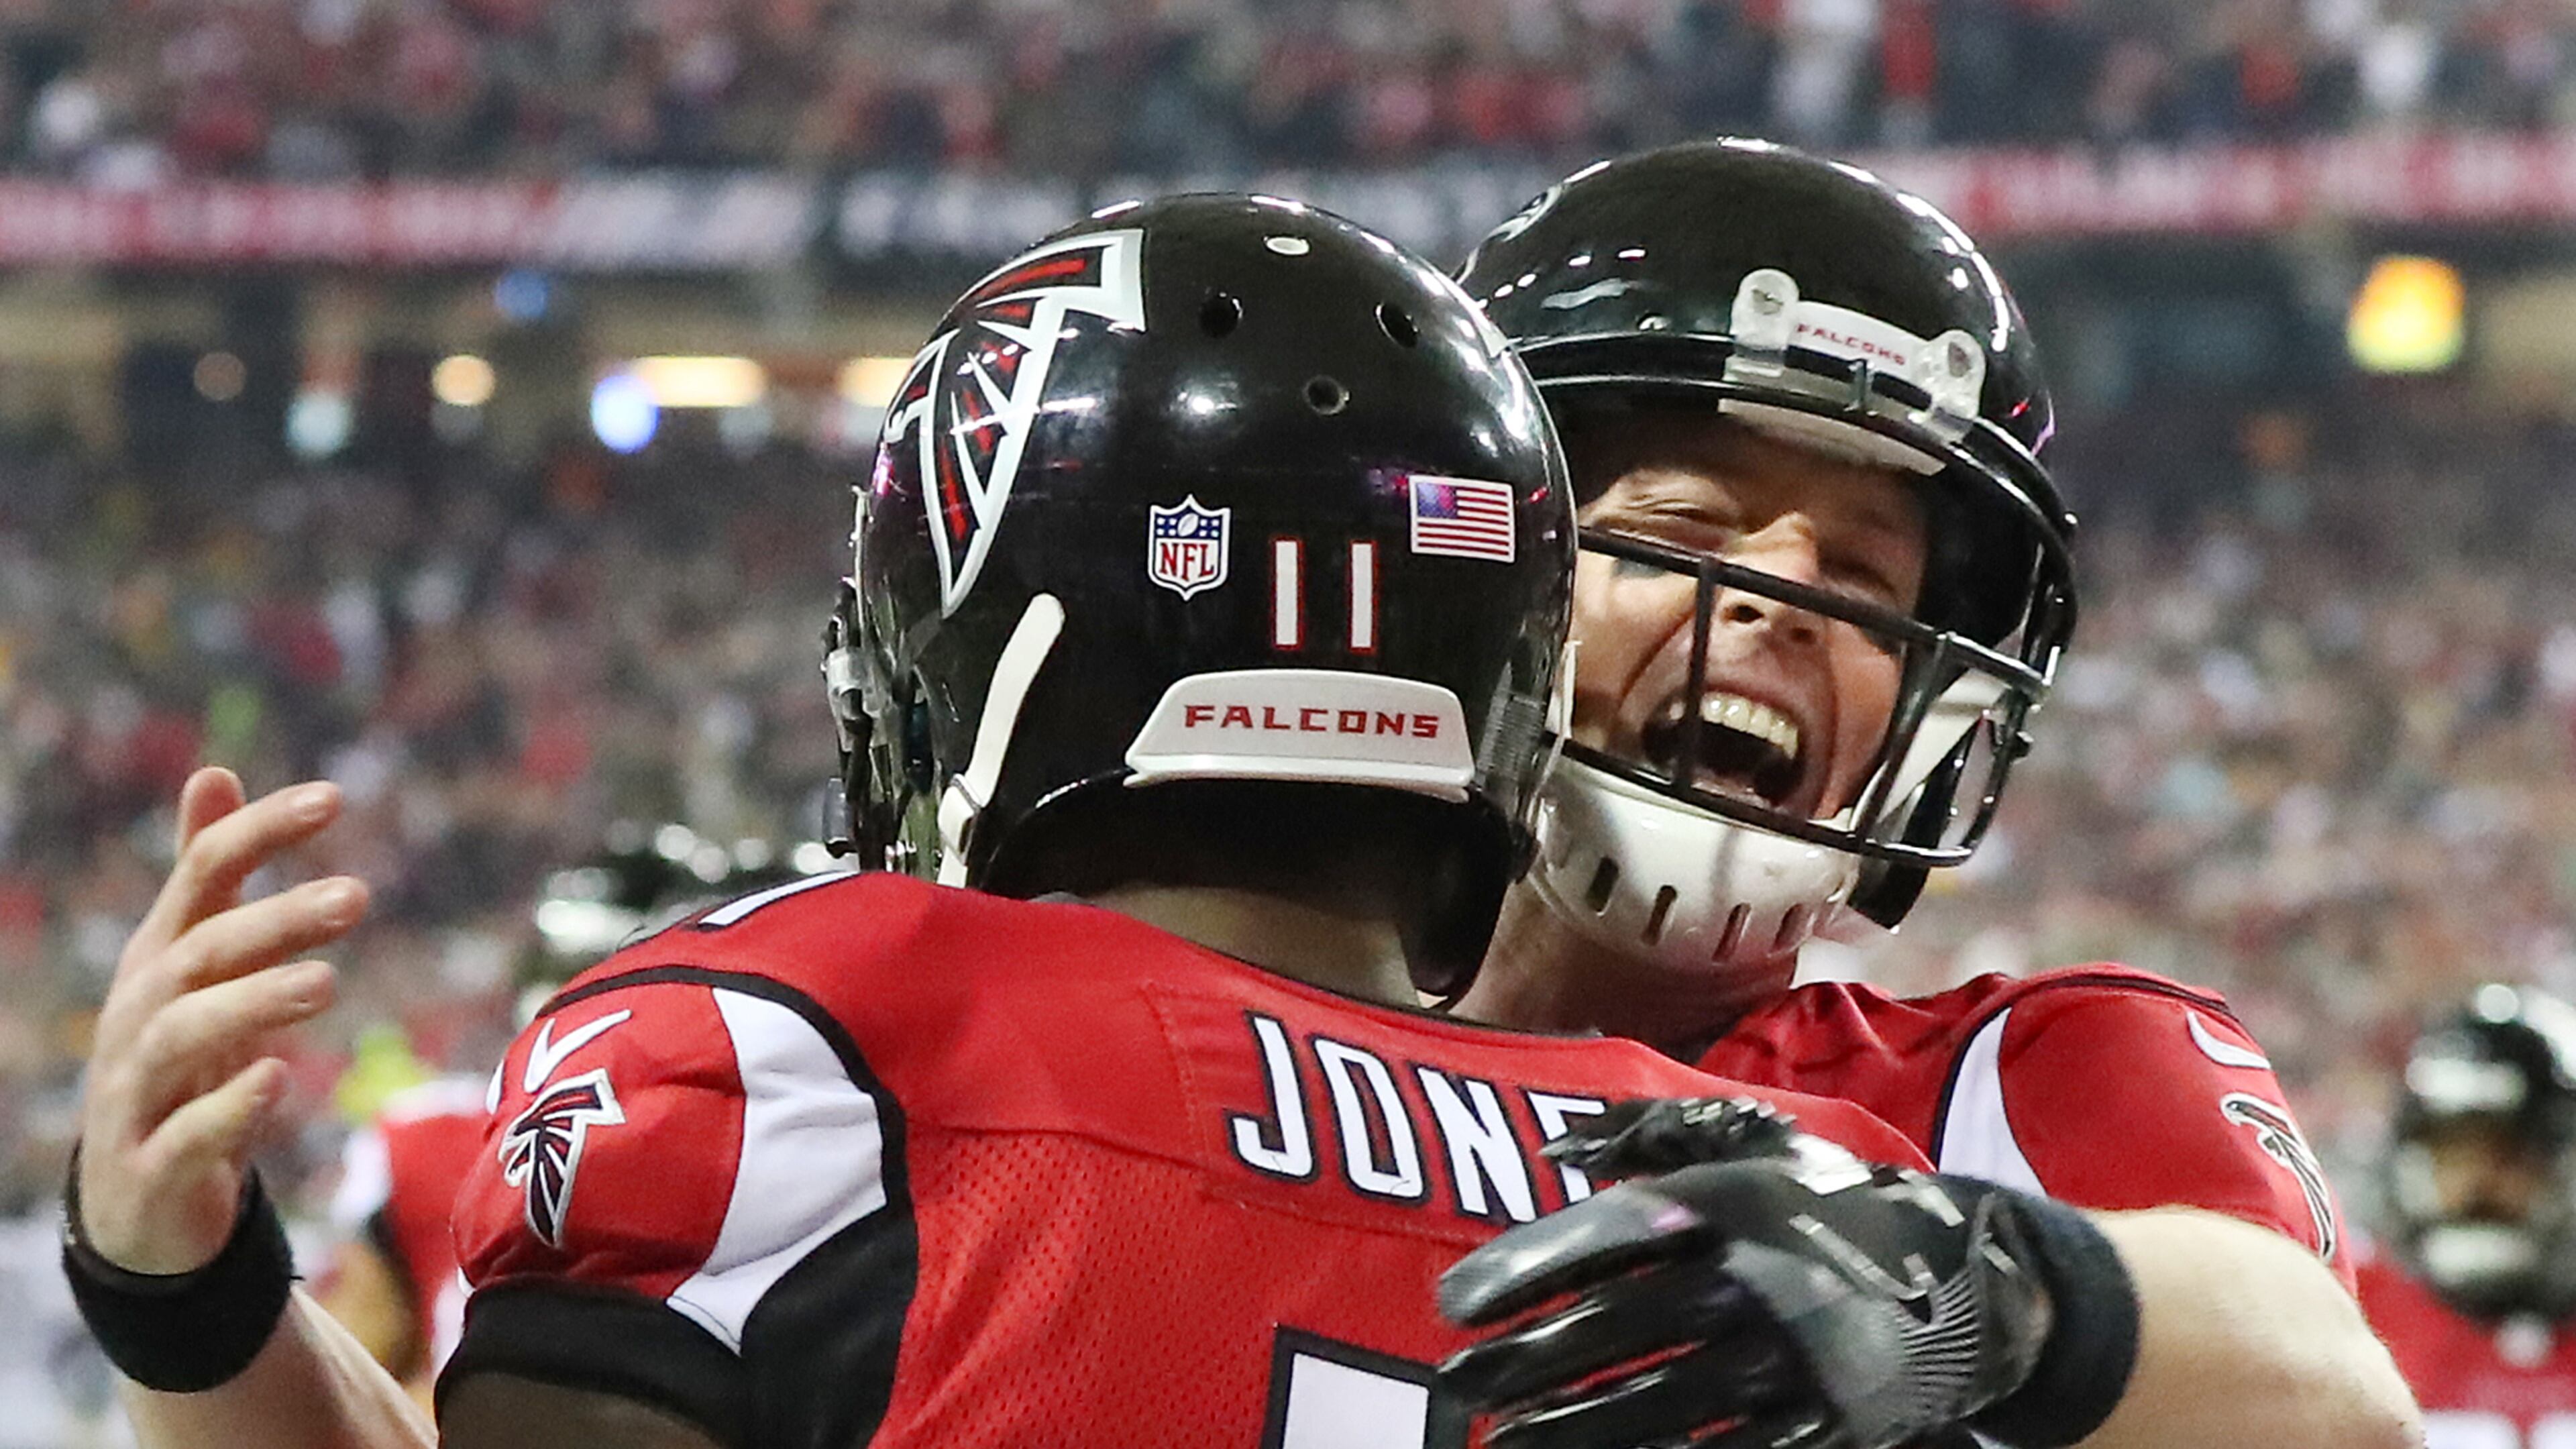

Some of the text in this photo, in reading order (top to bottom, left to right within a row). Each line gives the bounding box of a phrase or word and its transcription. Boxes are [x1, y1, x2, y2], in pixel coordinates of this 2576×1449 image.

[1797, 323, 1905, 366] FALCONS
[1159, 542, 1215, 582] NFL
[1272, 536, 1378, 655] 11
[1184, 704, 1439, 739] FALCONS
